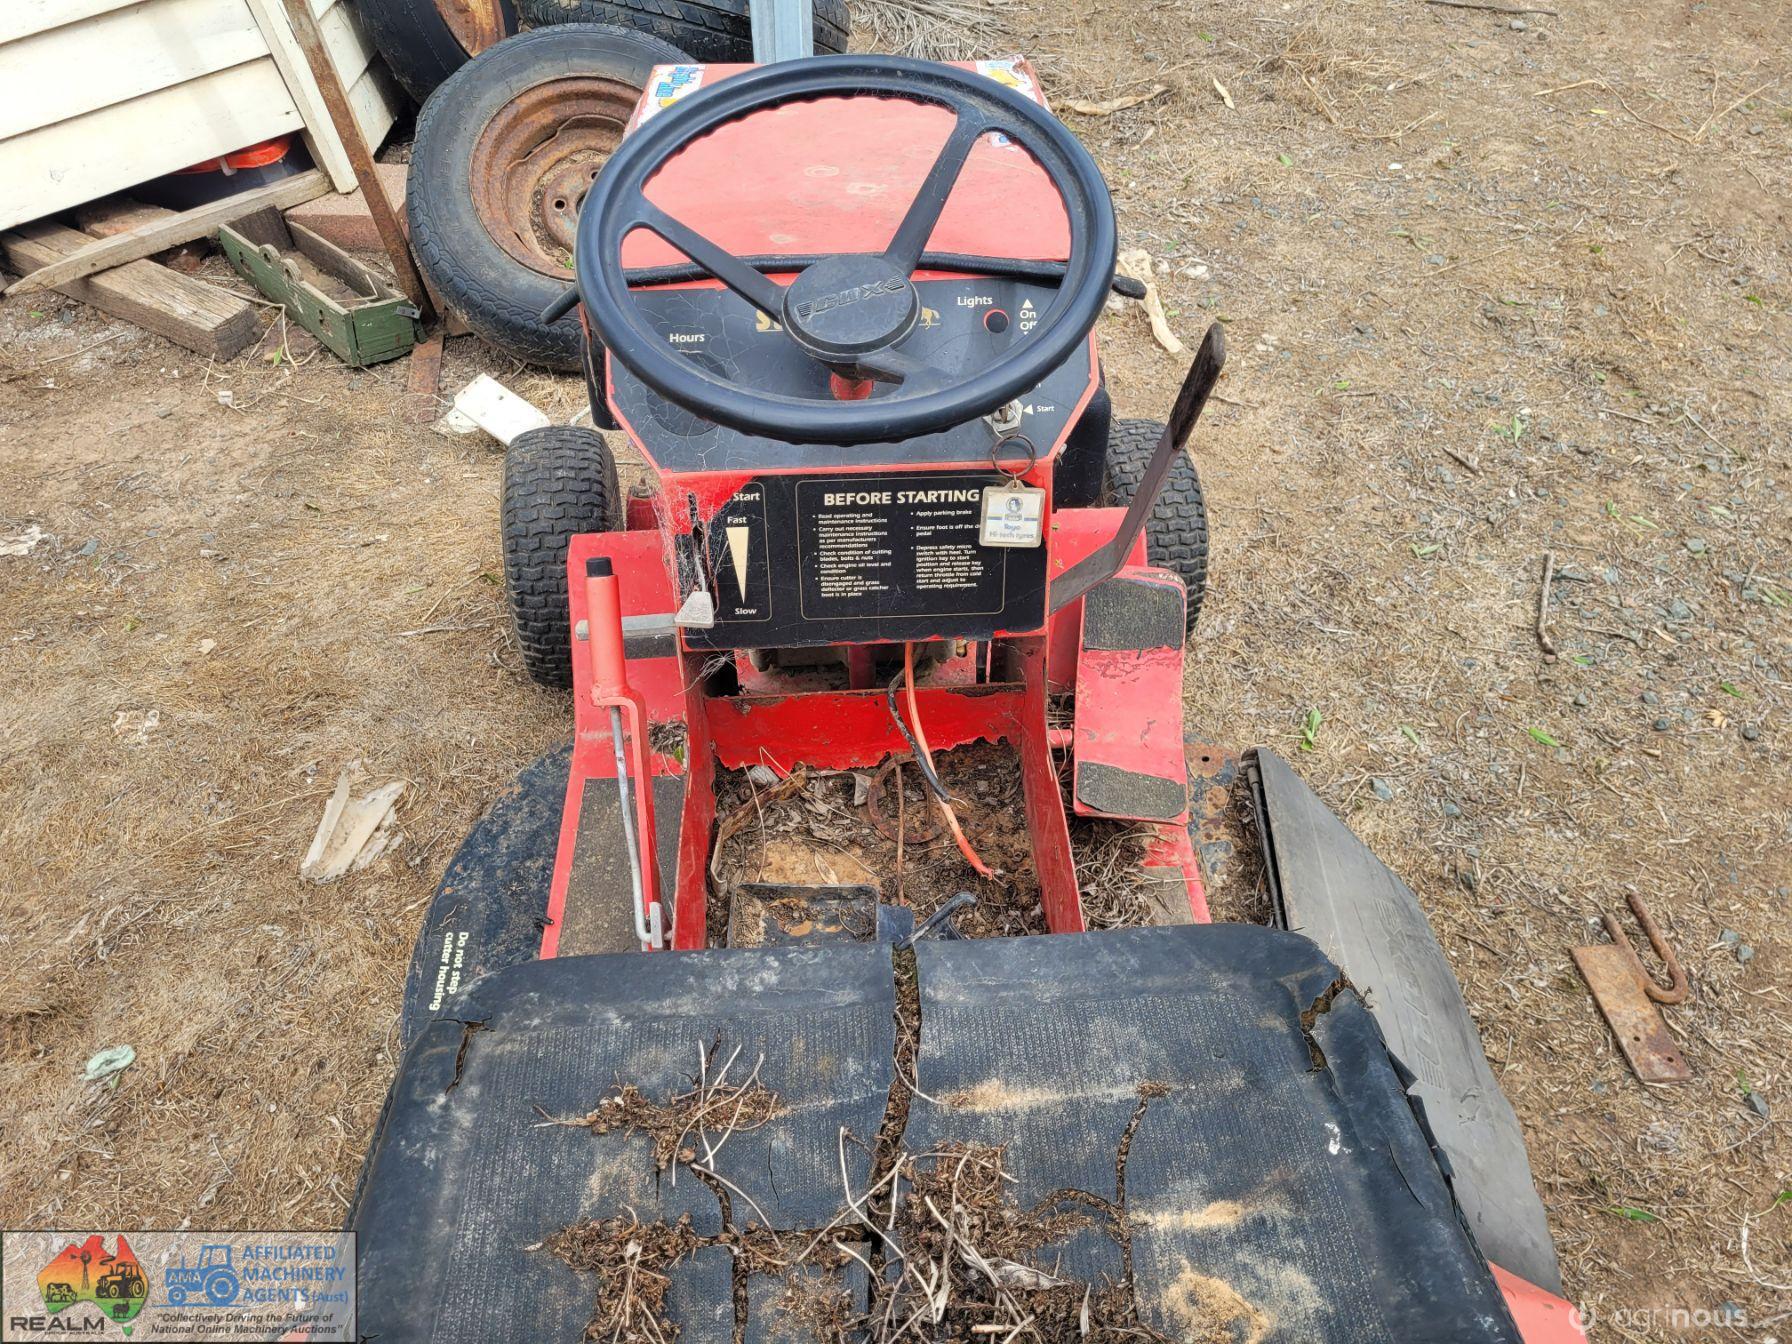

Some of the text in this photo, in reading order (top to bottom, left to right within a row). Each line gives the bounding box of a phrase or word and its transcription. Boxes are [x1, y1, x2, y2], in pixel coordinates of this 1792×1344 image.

[957, 296, 993, 308] Lights
[1020, 310, 1036, 318] On
[669, 333, 705, 343] Hours
[733, 493, 760, 501] Start
[824, 489, 980, 506] BEFORE STARTING
[447, 932, 469, 994] Do not step
[429, 932, 453, 1011] cutter housing
